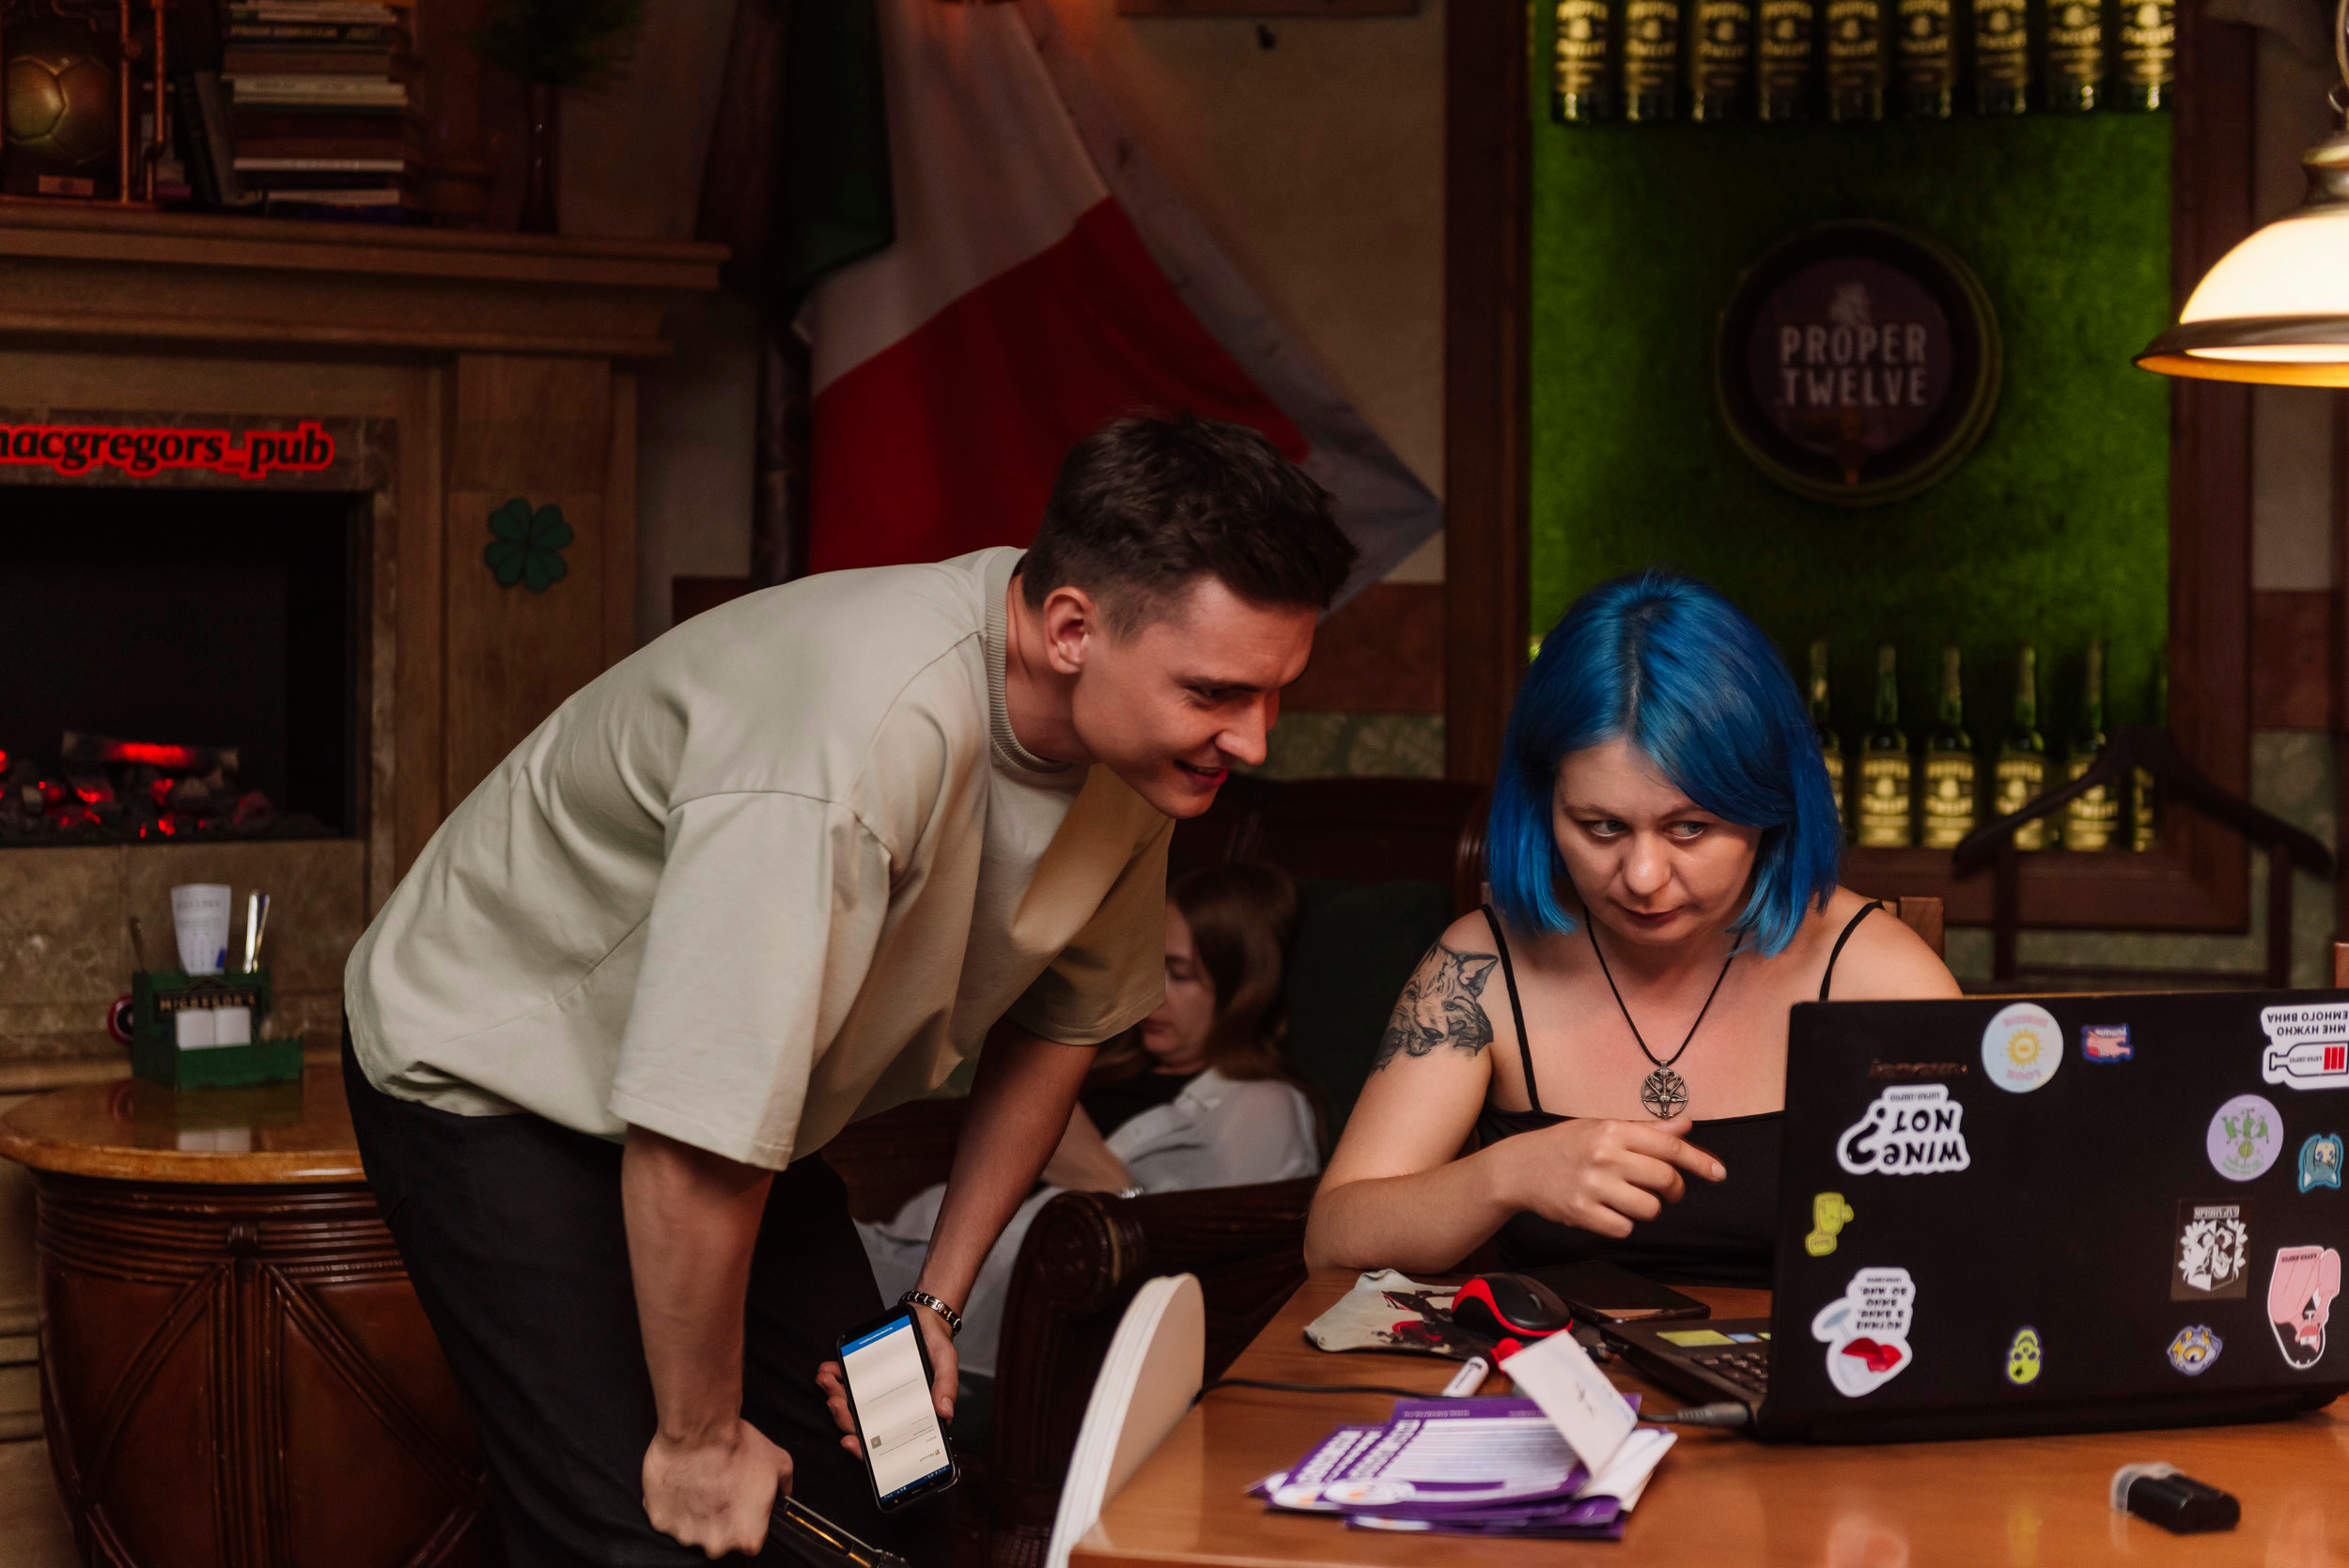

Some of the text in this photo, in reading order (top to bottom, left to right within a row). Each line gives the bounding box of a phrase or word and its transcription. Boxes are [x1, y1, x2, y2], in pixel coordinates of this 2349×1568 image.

[1780, 324, 1927, 365] PROPER
[1781, 367, 1926, 407] TWELVE
[2267, 1010, 2349, 1023] ЕМНОГО ВИНА
[2277, 1023, 2346, 1036] МНЕ НУЖНО
